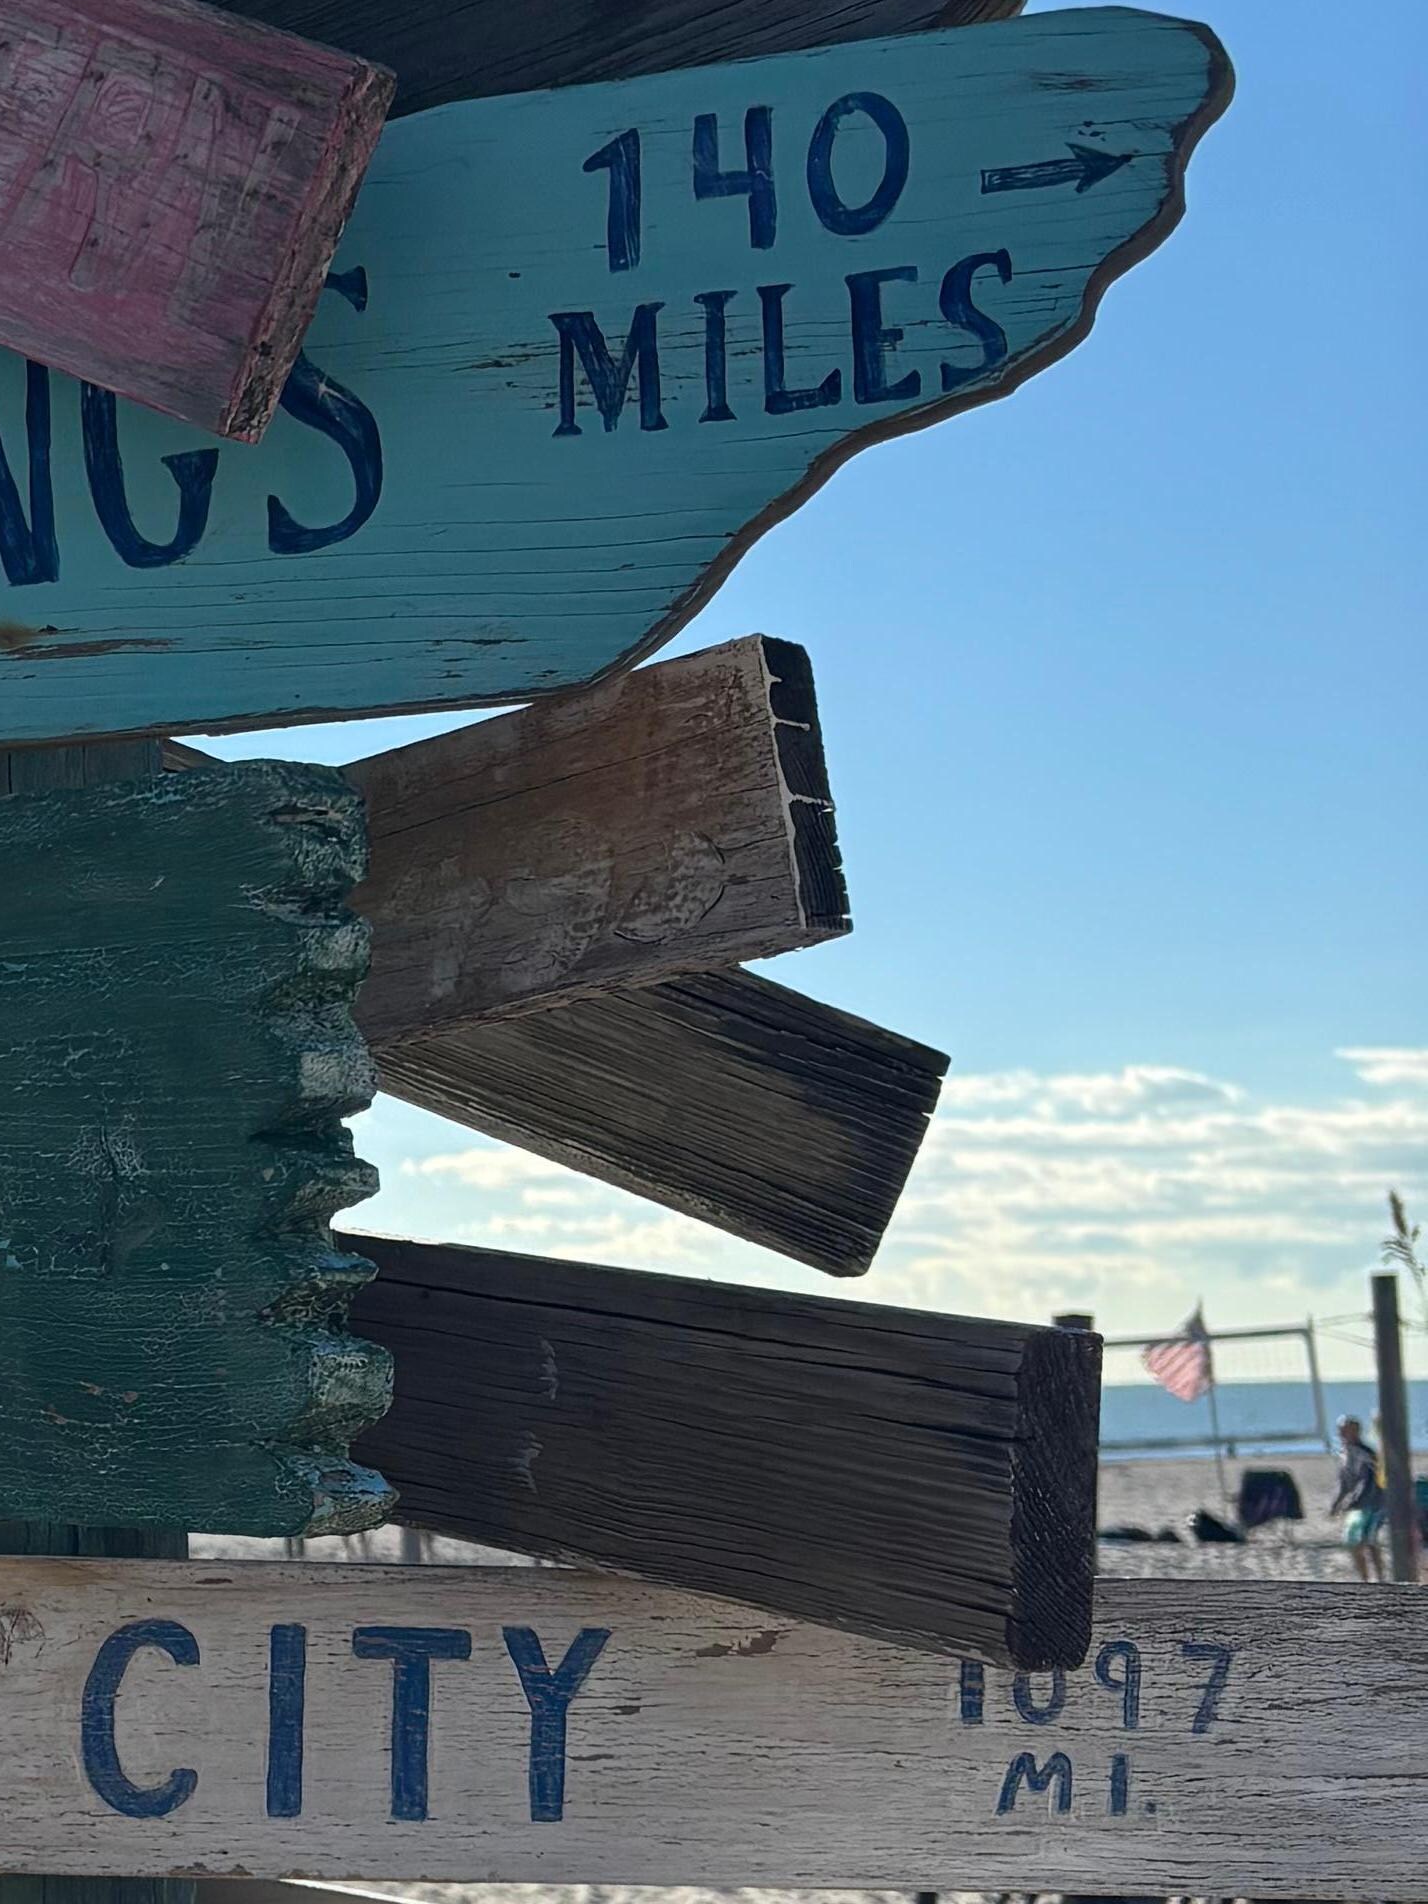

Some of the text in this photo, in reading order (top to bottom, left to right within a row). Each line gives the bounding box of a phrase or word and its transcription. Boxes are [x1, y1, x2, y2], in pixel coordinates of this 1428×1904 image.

[582, 90, 912, 273] 140
[546, 247, 1014, 439] MILES
[82, 1618, 615, 1824] CITY
